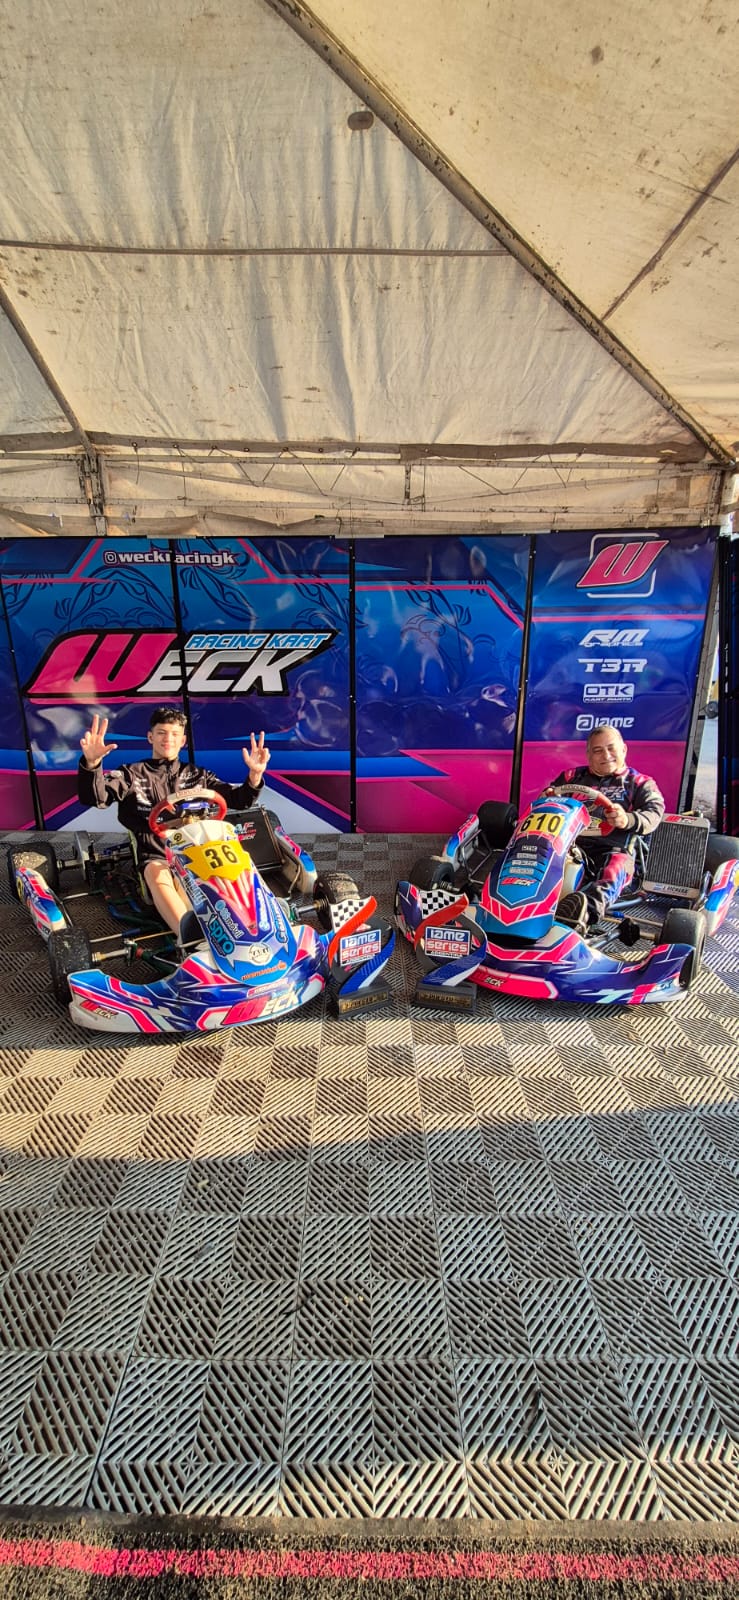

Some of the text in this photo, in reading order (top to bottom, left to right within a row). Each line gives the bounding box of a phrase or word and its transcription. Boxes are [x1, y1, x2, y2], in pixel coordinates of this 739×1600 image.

[184, 634, 331, 649] RACING KART
[27, 633, 315, 693] WECK
[585, 686, 632, 695] OTK
[520, 814, 560, 832] 610
[205, 845, 238, 869] 36
[427, 940, 468, 952] series
